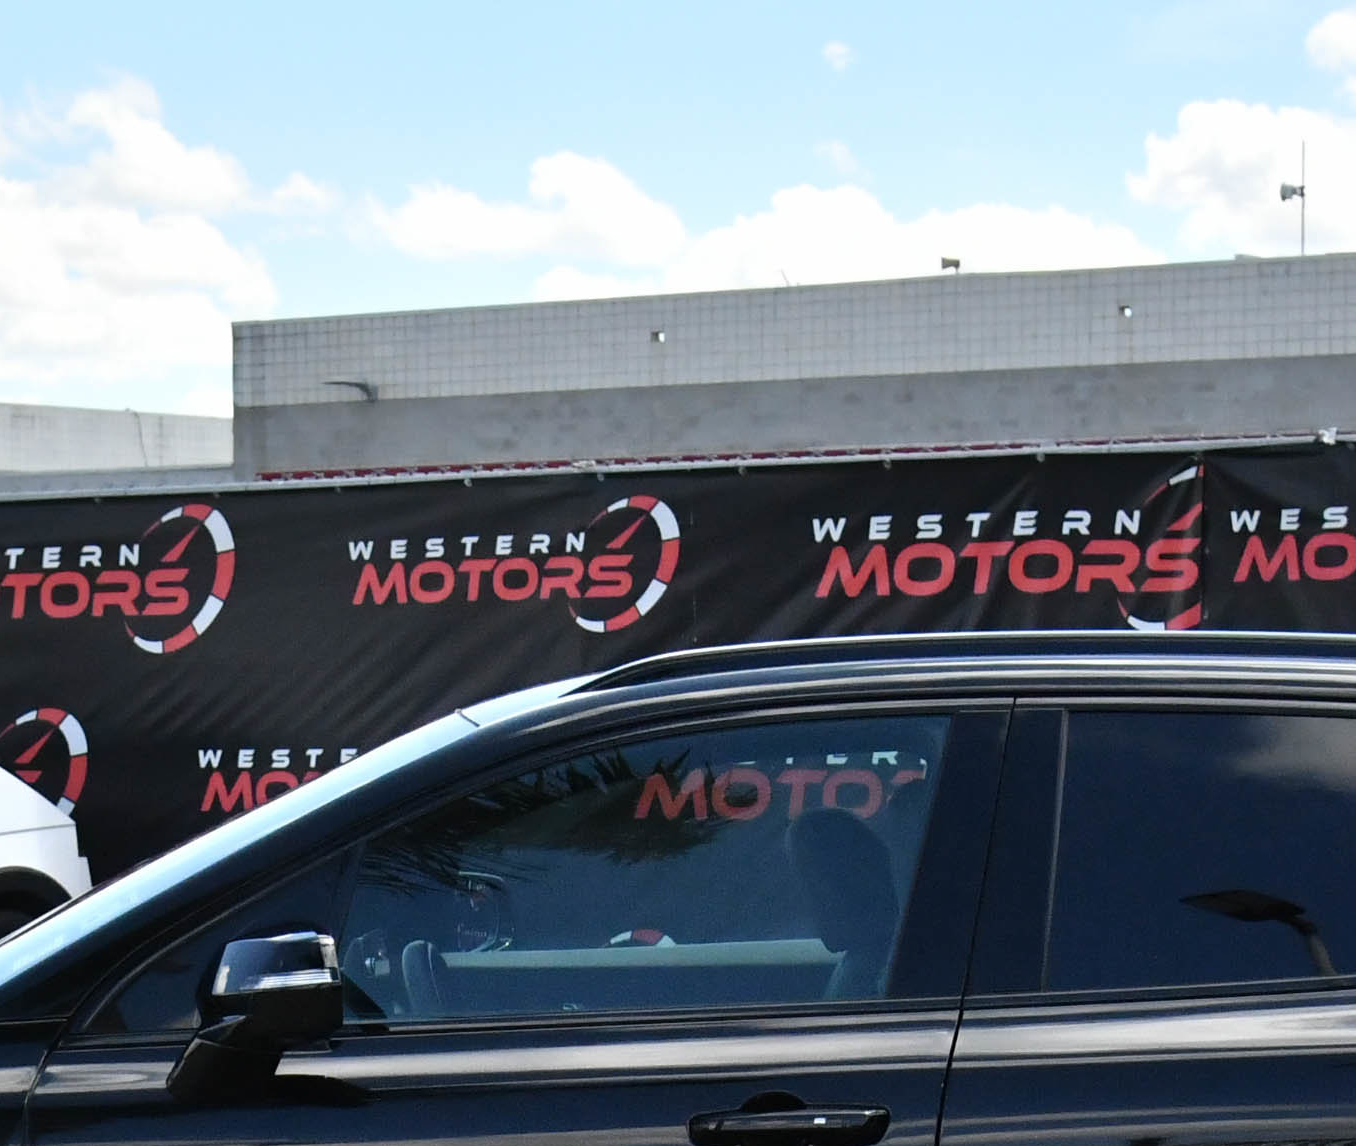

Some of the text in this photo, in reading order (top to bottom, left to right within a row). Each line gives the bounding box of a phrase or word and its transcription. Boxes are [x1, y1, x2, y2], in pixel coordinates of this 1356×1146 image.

[348, 531, 586, 561] WESTERN
[812, 509, 1141, 543] WESTERN
[352, 553, 634, 606] MOTORS
[815, 537, 1201, 598] MOTORS
